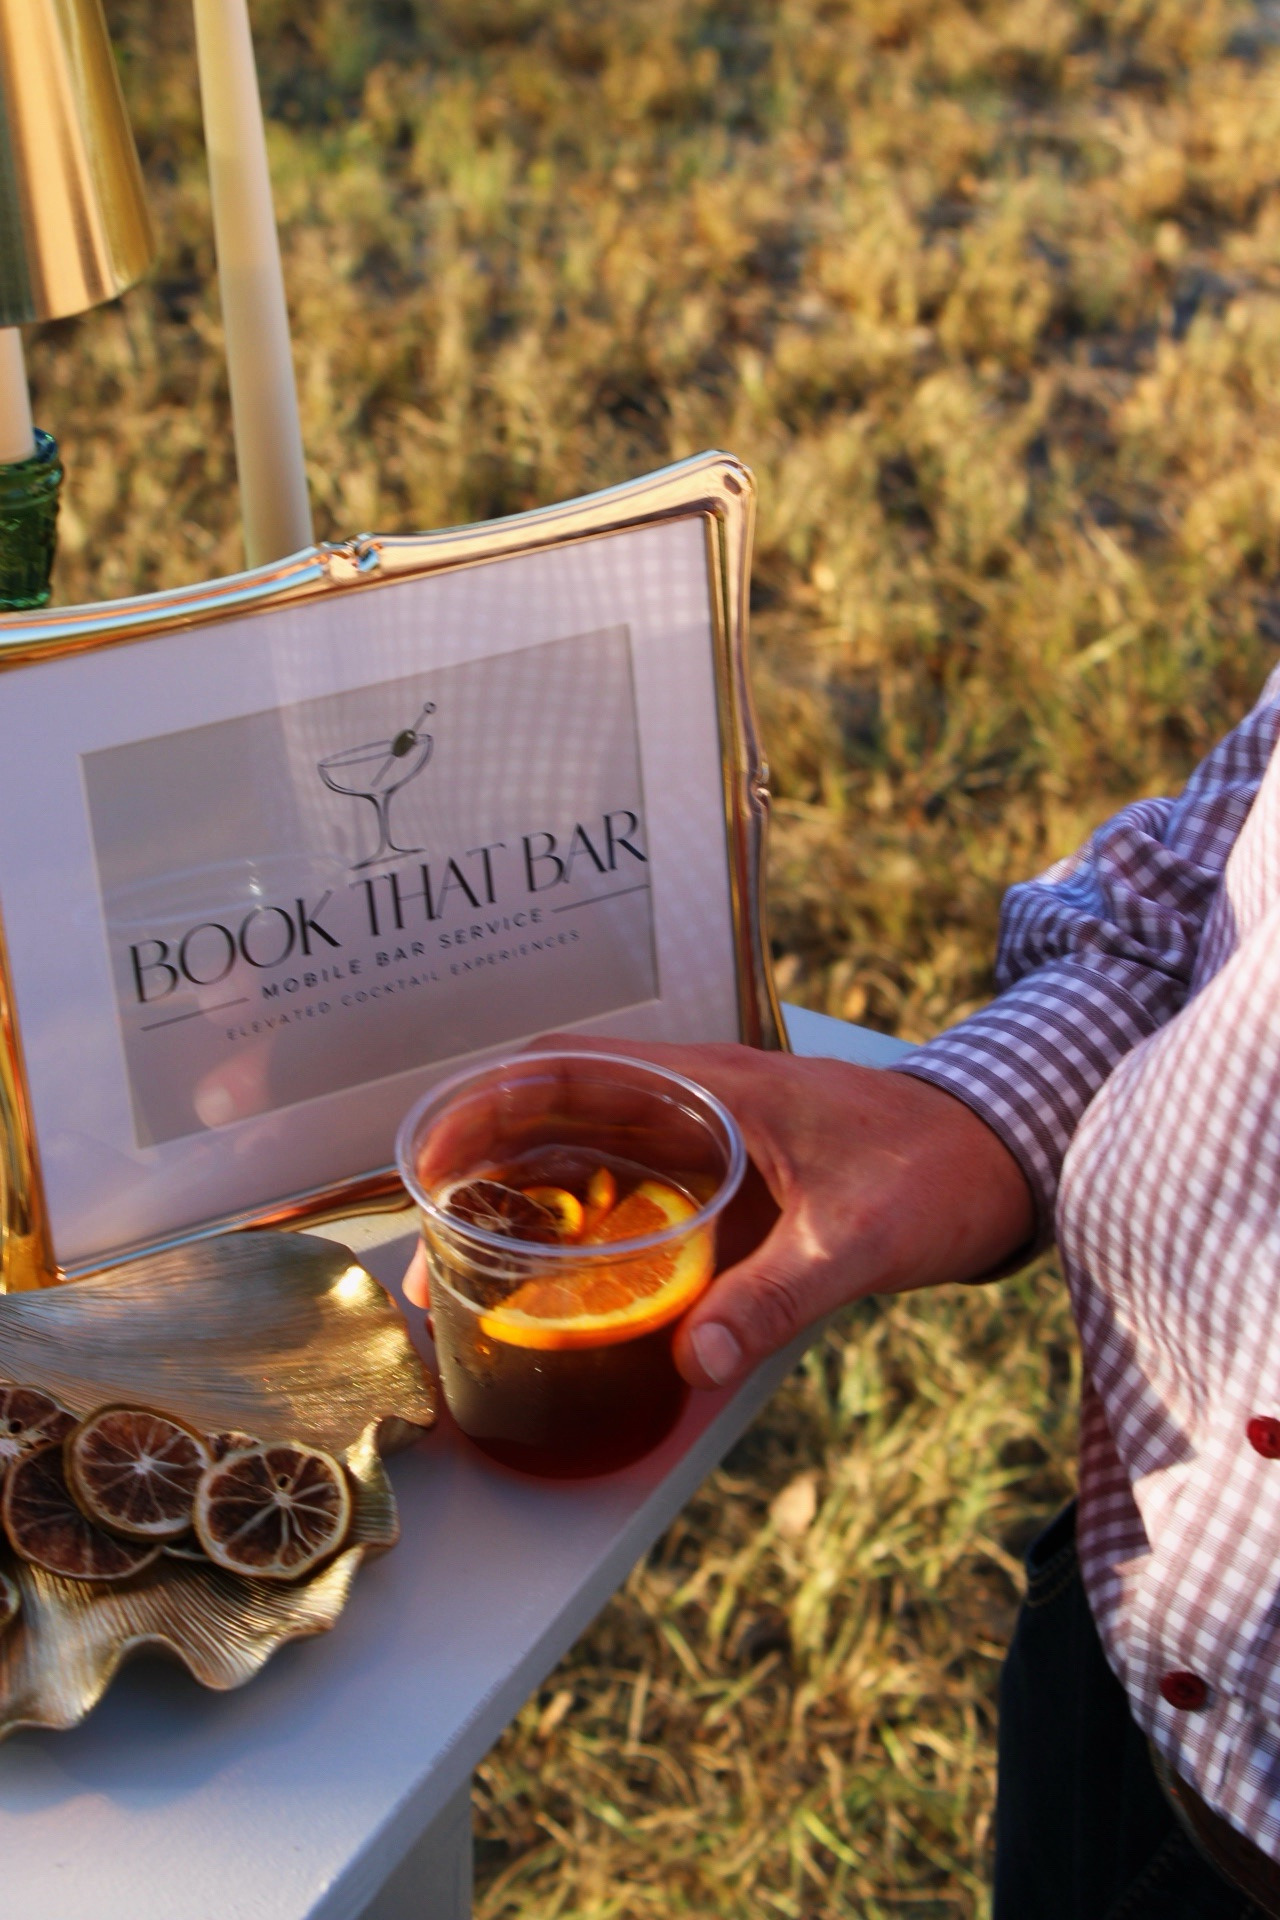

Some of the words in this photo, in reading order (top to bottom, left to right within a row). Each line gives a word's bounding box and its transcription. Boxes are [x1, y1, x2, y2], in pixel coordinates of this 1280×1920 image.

[129, 889, 342, 1004] BOOK
[349, 842, 507, 936] THAT
[522, 810, 648, 892] BAR
[262, 958, 362, 1000] MOBILE
[375, 941, 426, 968] BAR
[438, 908, 543, 949] SERVICE
[226, 1001, 332, 1041] ELEVATED
[340, 970, 440, 1007] COCKTAIL
[450, 929, 580, 976] EXPERIENCES
